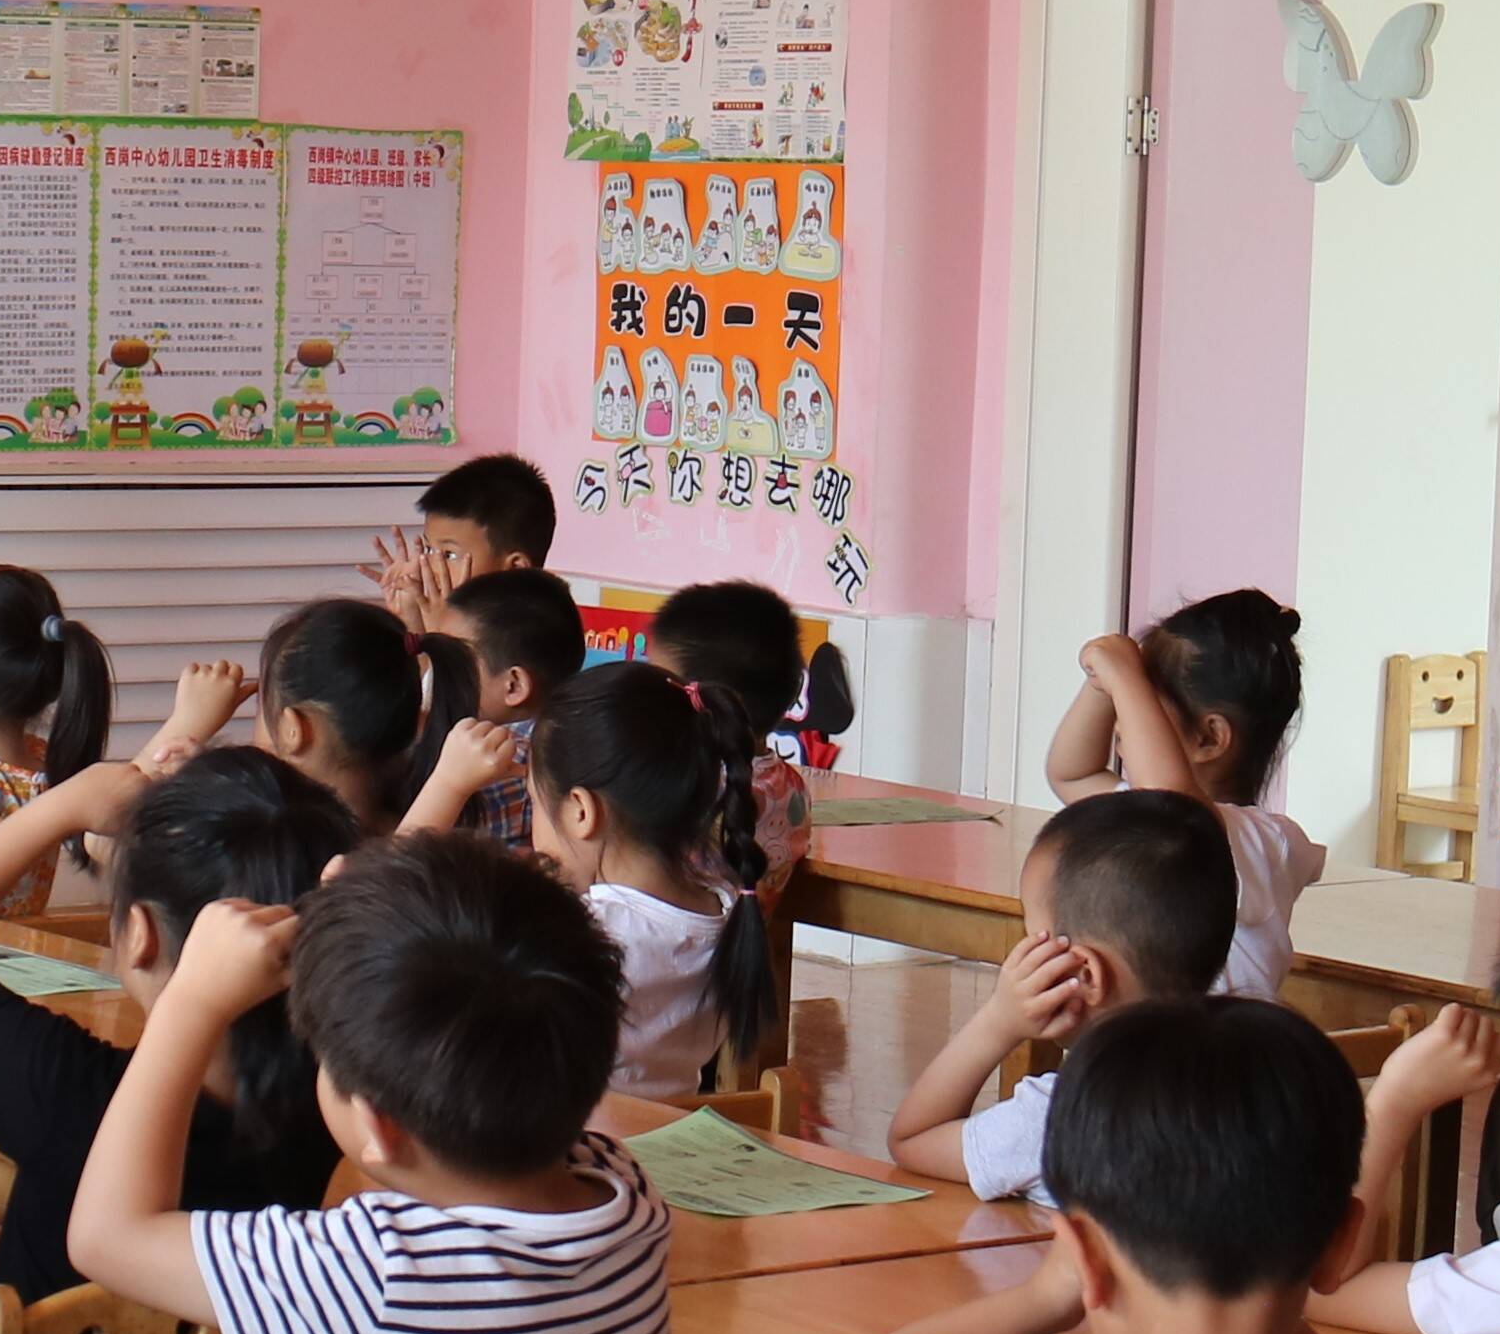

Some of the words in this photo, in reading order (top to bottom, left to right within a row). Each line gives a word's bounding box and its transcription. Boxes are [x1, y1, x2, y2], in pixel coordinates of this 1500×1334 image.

[104, 146, 275, 169] 西岗中心幼儿园卫生消毒制度
[610, 283, 824, 351] 我的一天
